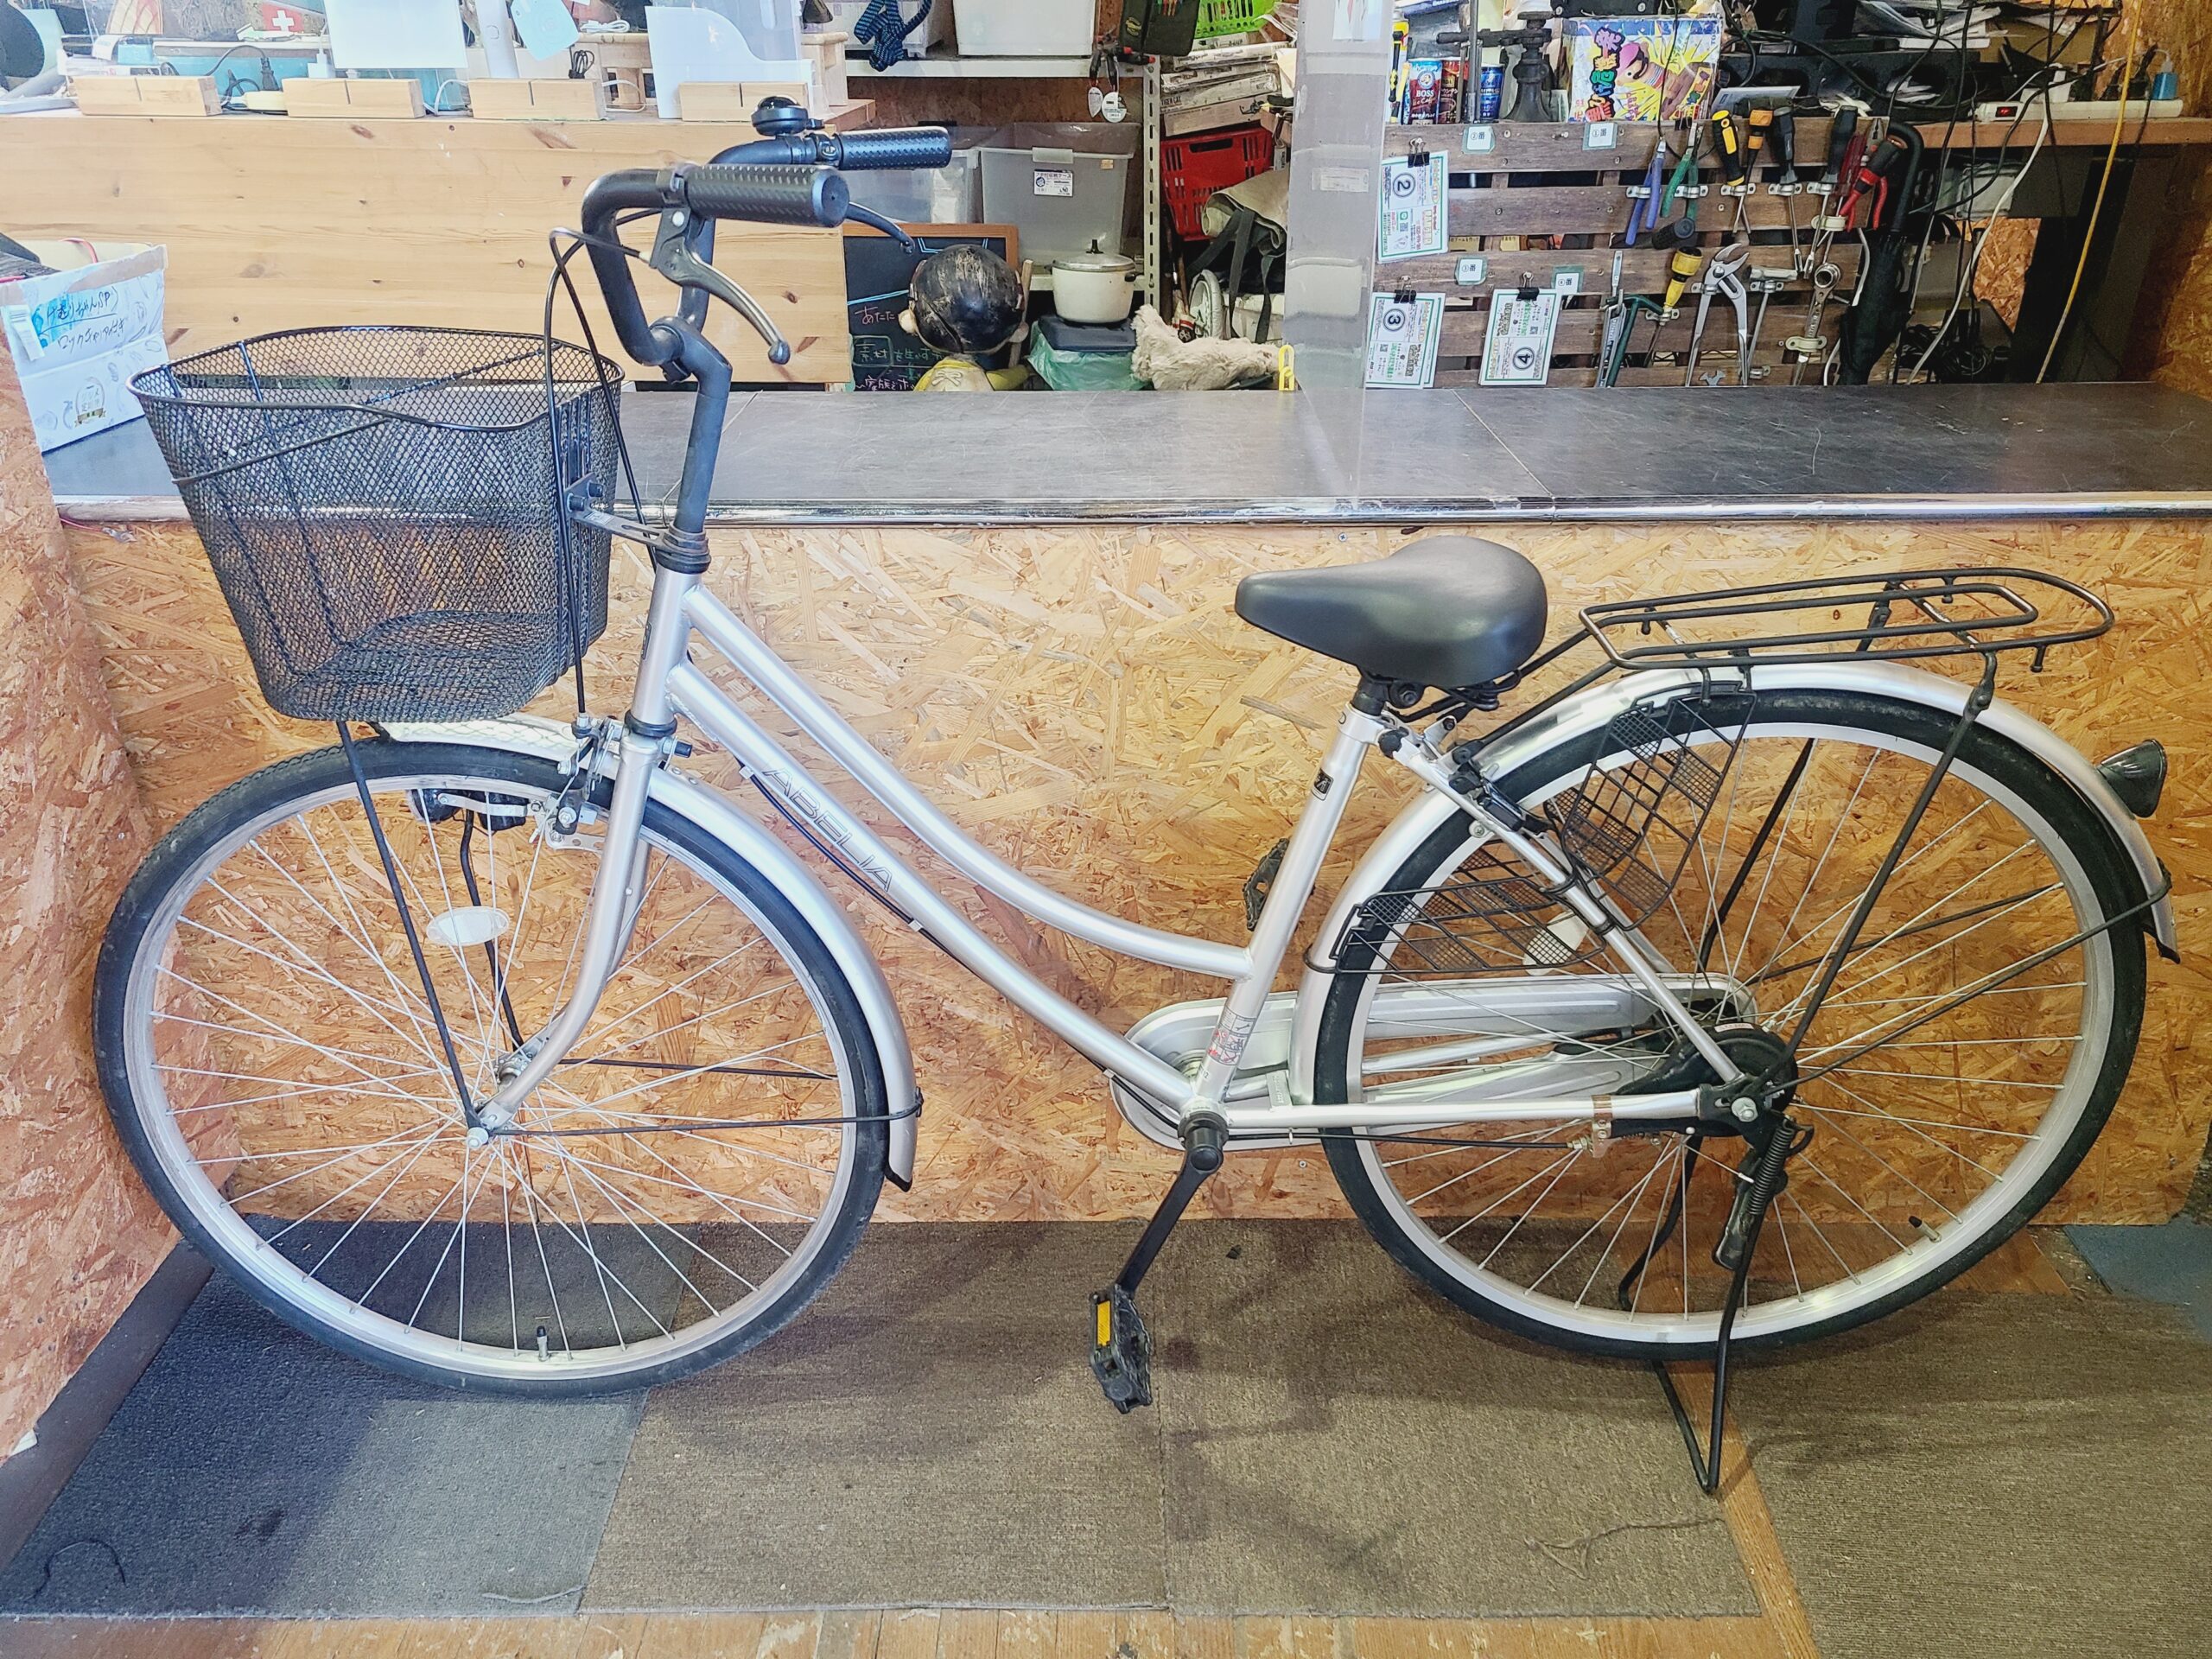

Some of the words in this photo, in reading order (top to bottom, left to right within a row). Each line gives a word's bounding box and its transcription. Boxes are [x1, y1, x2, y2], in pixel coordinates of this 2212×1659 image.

[1585, 27, 1625, 122] 黒ひげ危機一発
[854, 306, 899, 325] あたた
[762, 767, 893, 893] ABELIA
